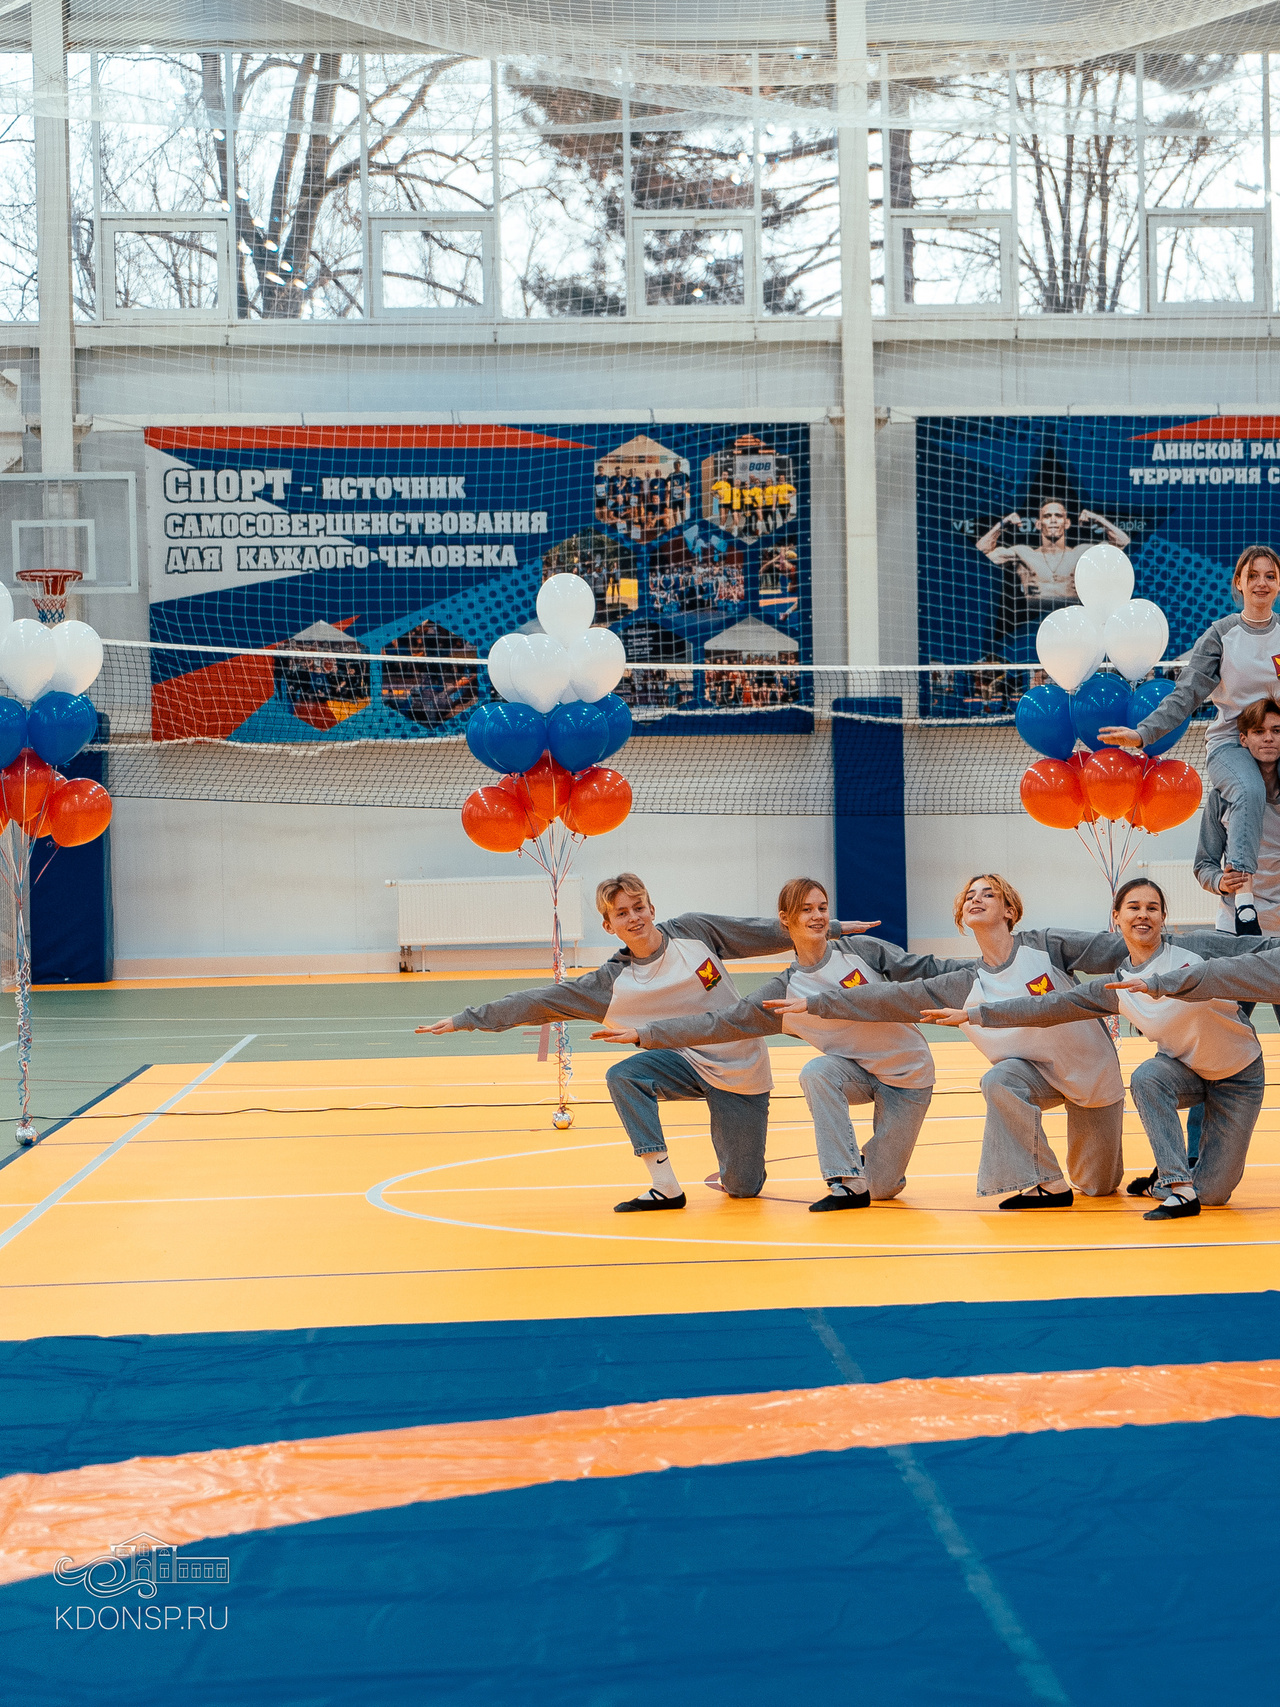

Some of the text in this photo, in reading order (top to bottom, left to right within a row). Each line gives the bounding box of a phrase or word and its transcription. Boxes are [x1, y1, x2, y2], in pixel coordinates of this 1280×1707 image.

[1151, 438, 1244, 461] ДИНСКОЙ
[164, 468, 292, 503] СПОРТ
[322, 476, 466, 500] ИСТОЧНИК
[1129, 467, 1261, 485] ТЕРРИТОРИЯ
[164, 511, 549, 539] САМОСОВЕРШЕНСТВОВАНИЯ
[164, 544, 519, 574] ДЛЯ КАЖДОГО ЧЕЛОВЕКА
